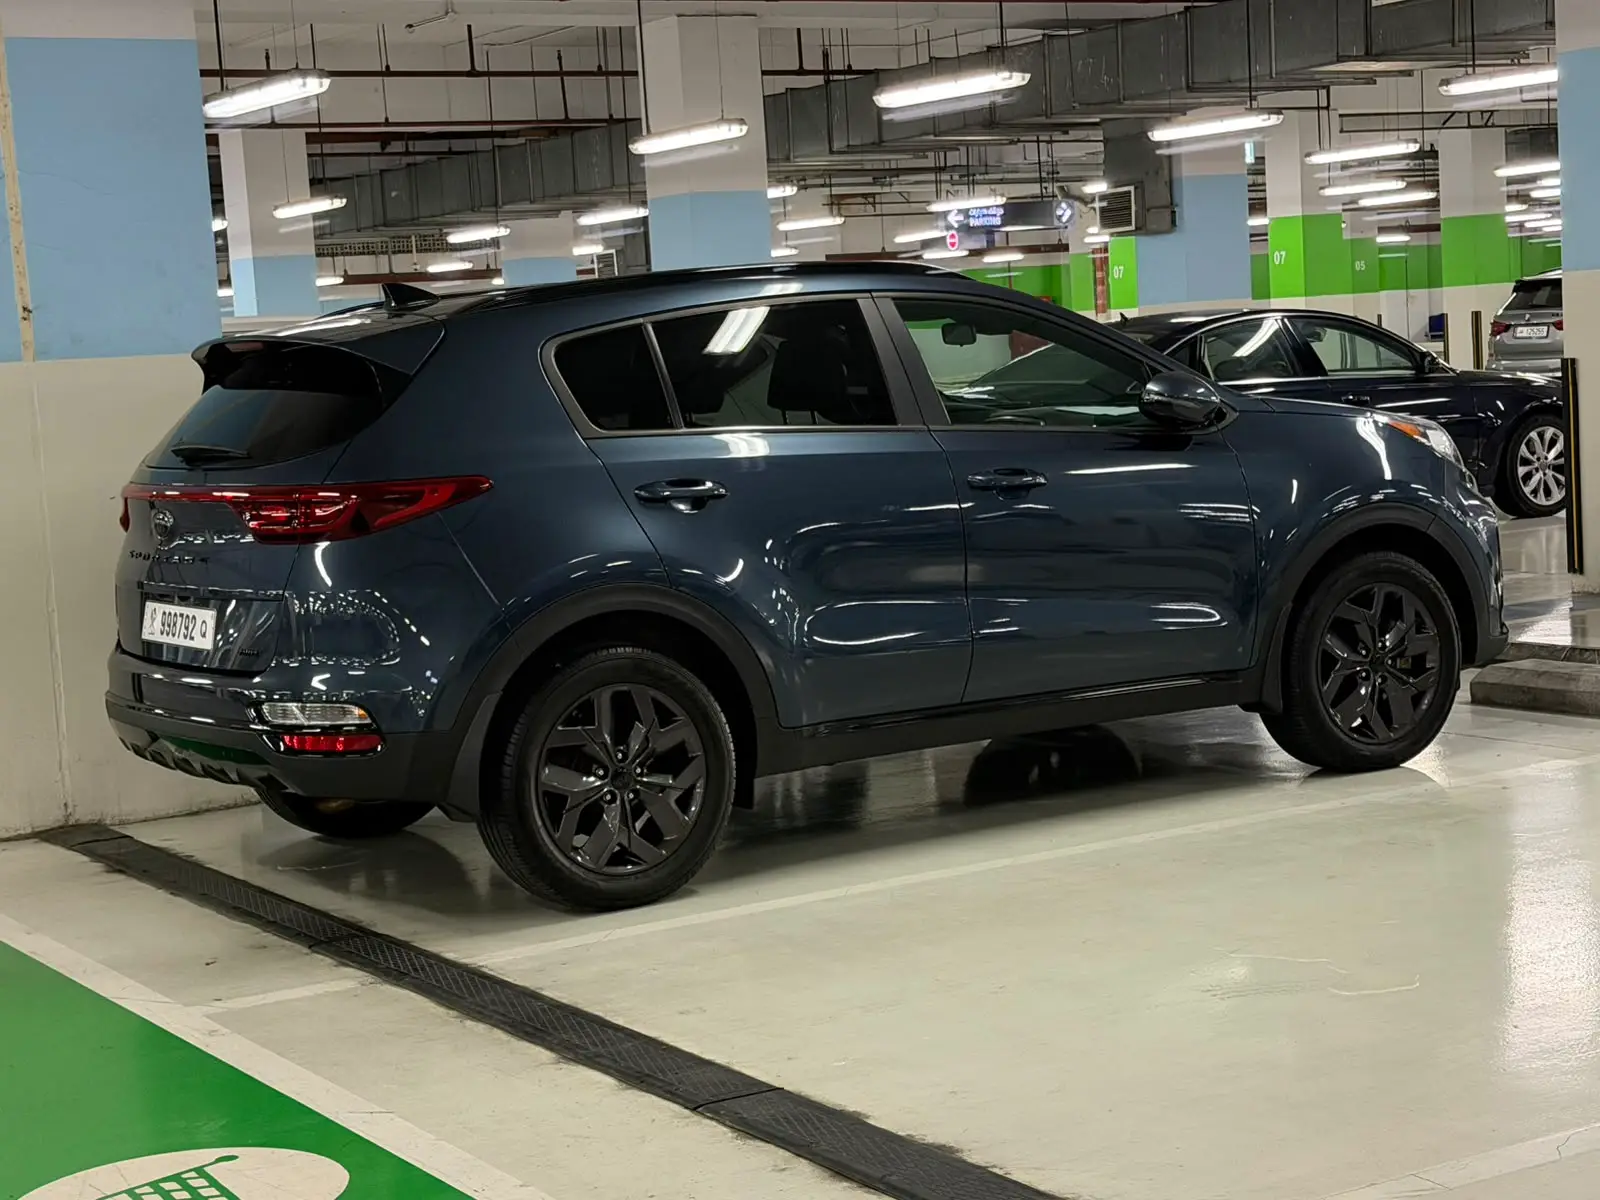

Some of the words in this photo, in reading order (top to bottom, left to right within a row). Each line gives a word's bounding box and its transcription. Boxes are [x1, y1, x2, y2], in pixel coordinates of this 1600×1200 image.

[1273, 250, 1286, 265] 07
[1113, 265, 1124, 279] 07
[1355, 260, 1366, 272] 05
[160, 610, 197, 641] 998792
[200, 619, 208, 639] Q
